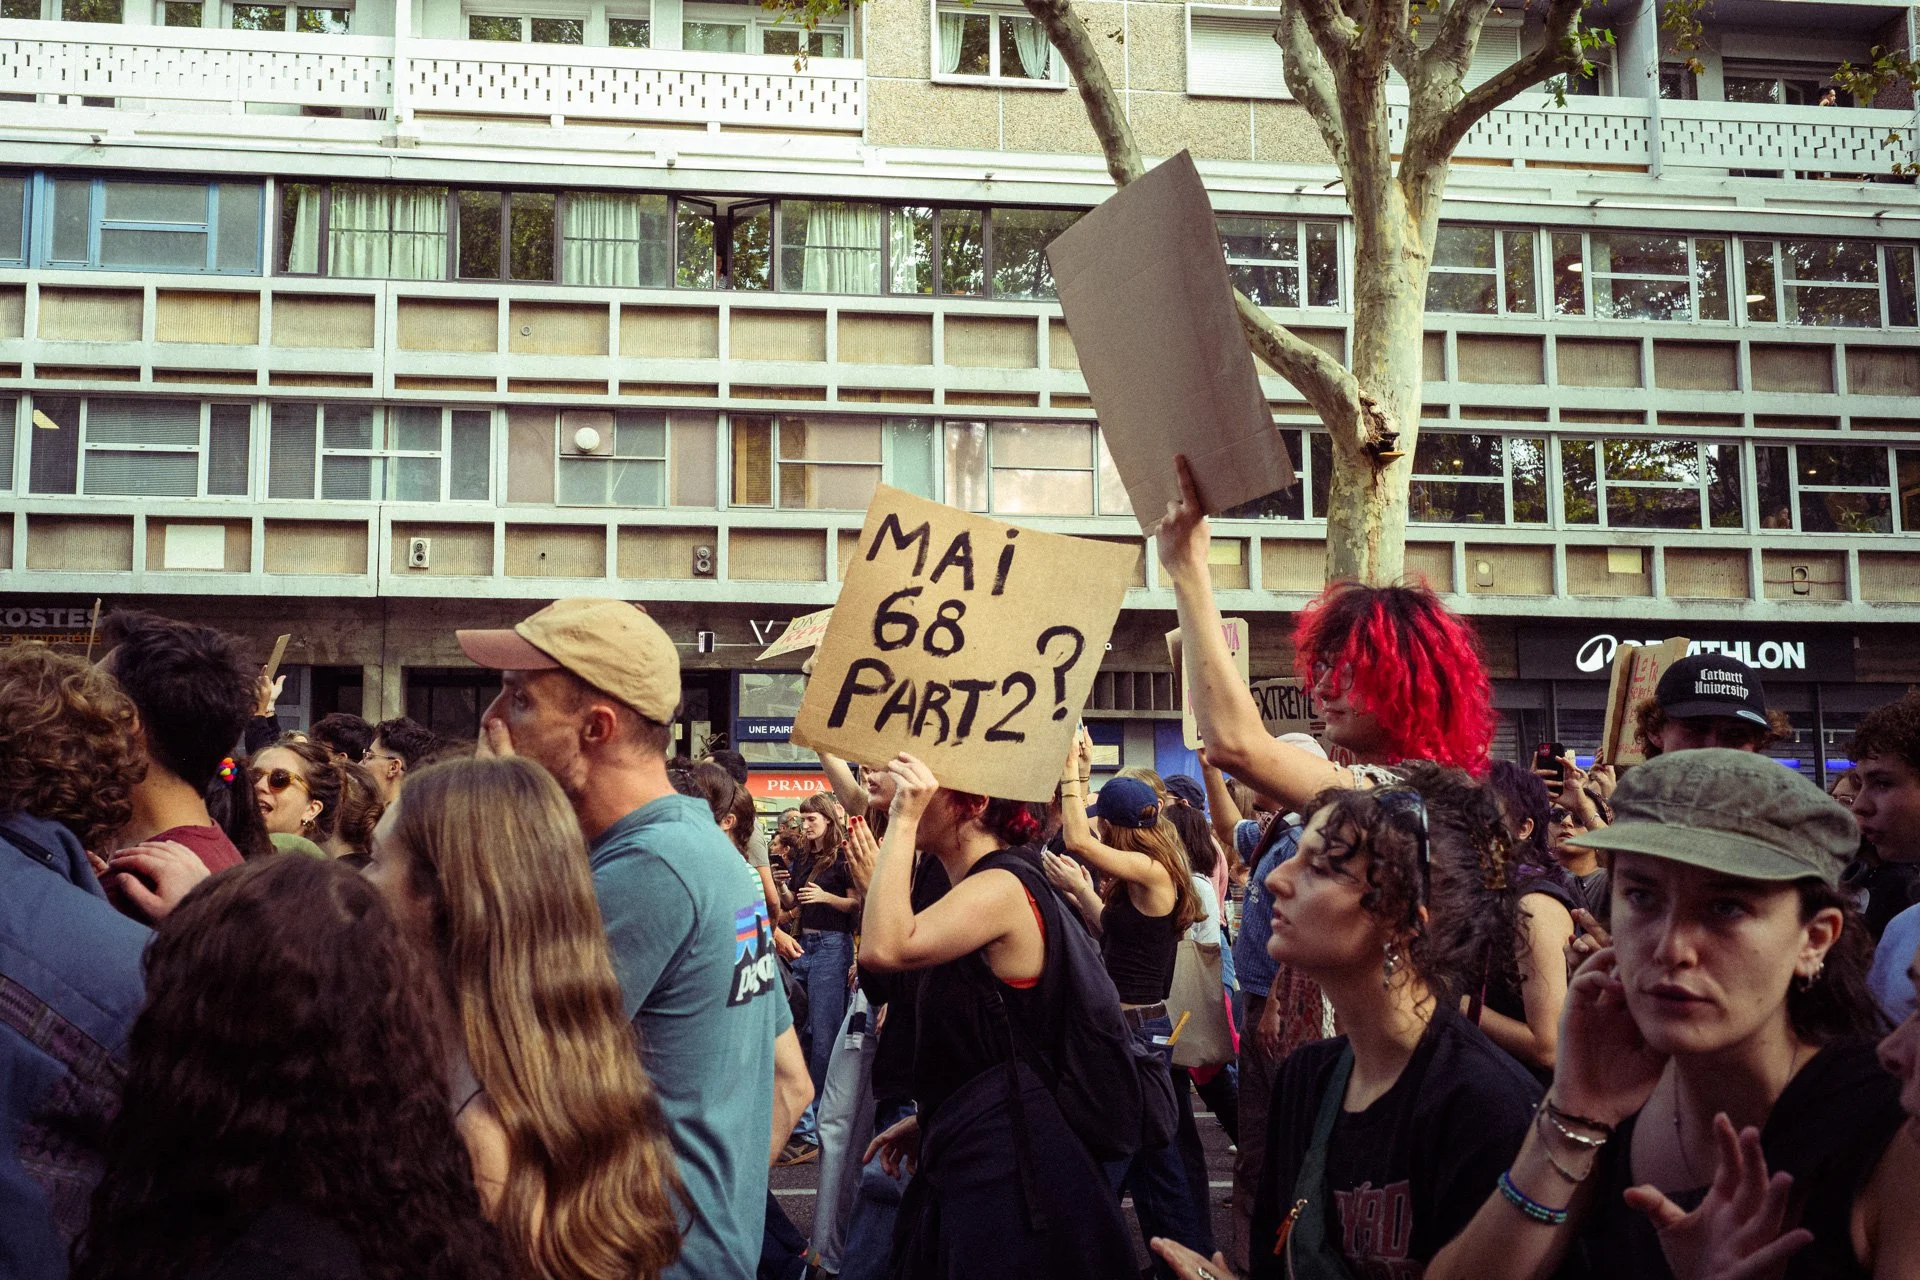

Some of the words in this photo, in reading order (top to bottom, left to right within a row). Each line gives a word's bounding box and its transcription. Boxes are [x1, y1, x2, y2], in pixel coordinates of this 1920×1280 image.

[873, 586, 967, 658] 68
[1623, 640, 1806, 669] ATHLON
[1700, 668, 1743, 684] Carhartt
[1694, 681, 1749, 700] University
[748, 725, 768, 734] UNE
[767, 779, 826, 791] PRADA
